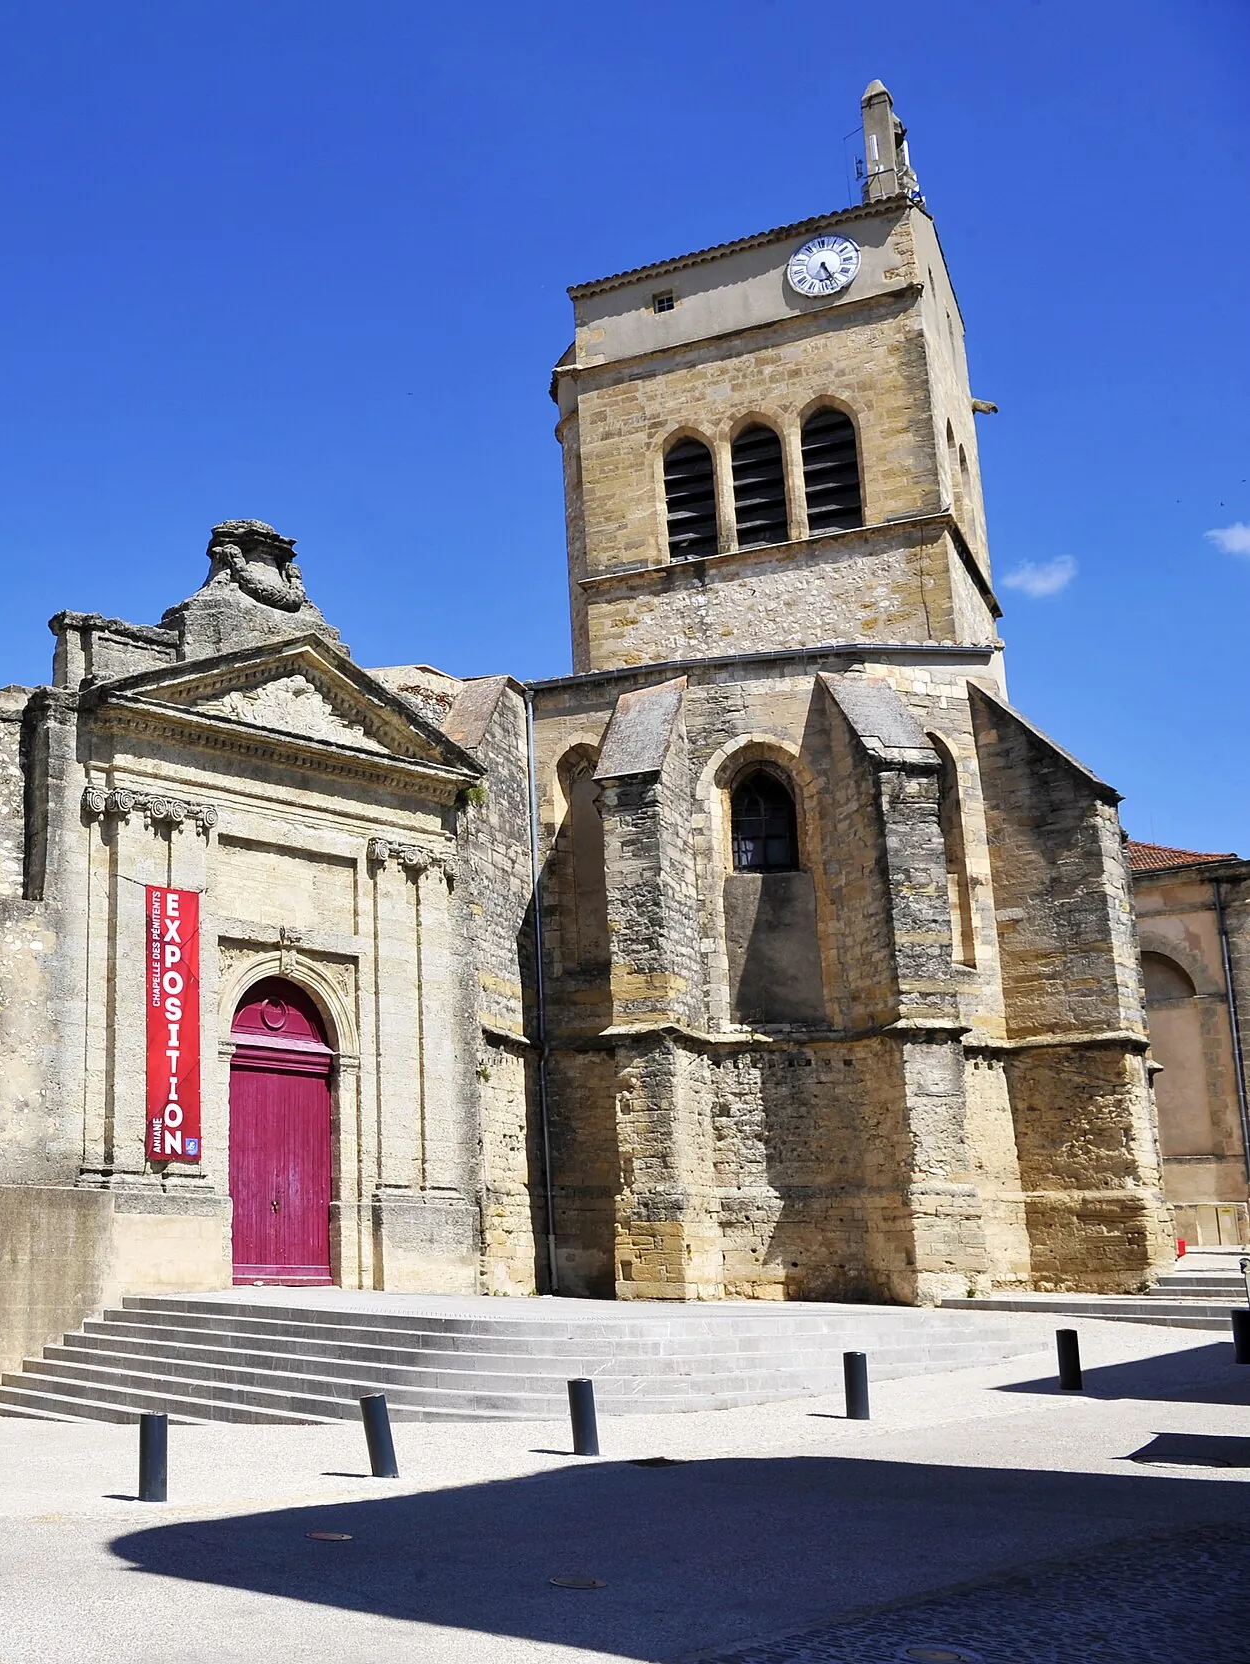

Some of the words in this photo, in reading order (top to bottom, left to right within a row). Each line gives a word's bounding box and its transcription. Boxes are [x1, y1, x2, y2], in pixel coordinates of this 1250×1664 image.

[151, 890, 161, 940] PÉNITENTS
[152, 941, 161, 960] DES
[152, 962, 161, 1007] CHAPELLE
[162, 893, 184, 1155] EXPOSITION
[153, 1117, 162, 1154] ANIANE
